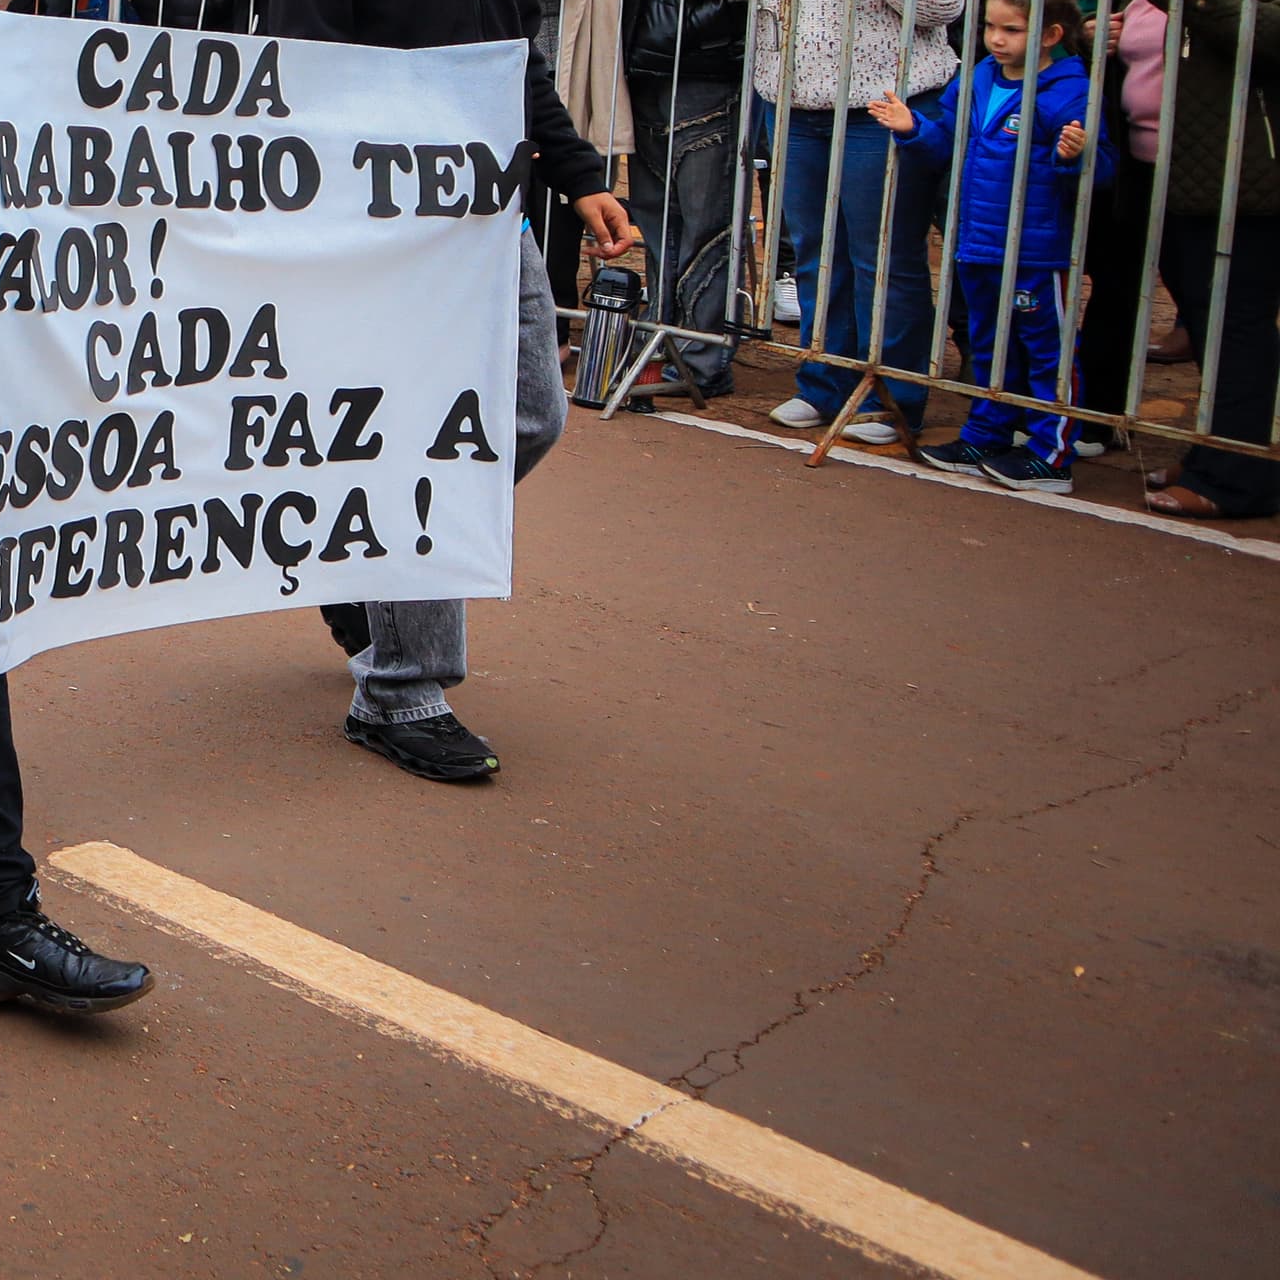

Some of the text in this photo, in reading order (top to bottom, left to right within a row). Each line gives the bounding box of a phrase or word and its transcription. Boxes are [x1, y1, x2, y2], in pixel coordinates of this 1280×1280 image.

[76, 27, 291, 118] CADA
[352, 140, 539, 219] TEM
[85, 302, 288, 402] CADA
[224, 386, 385, 472] FAZ
[425, 388, 500, 464] A
